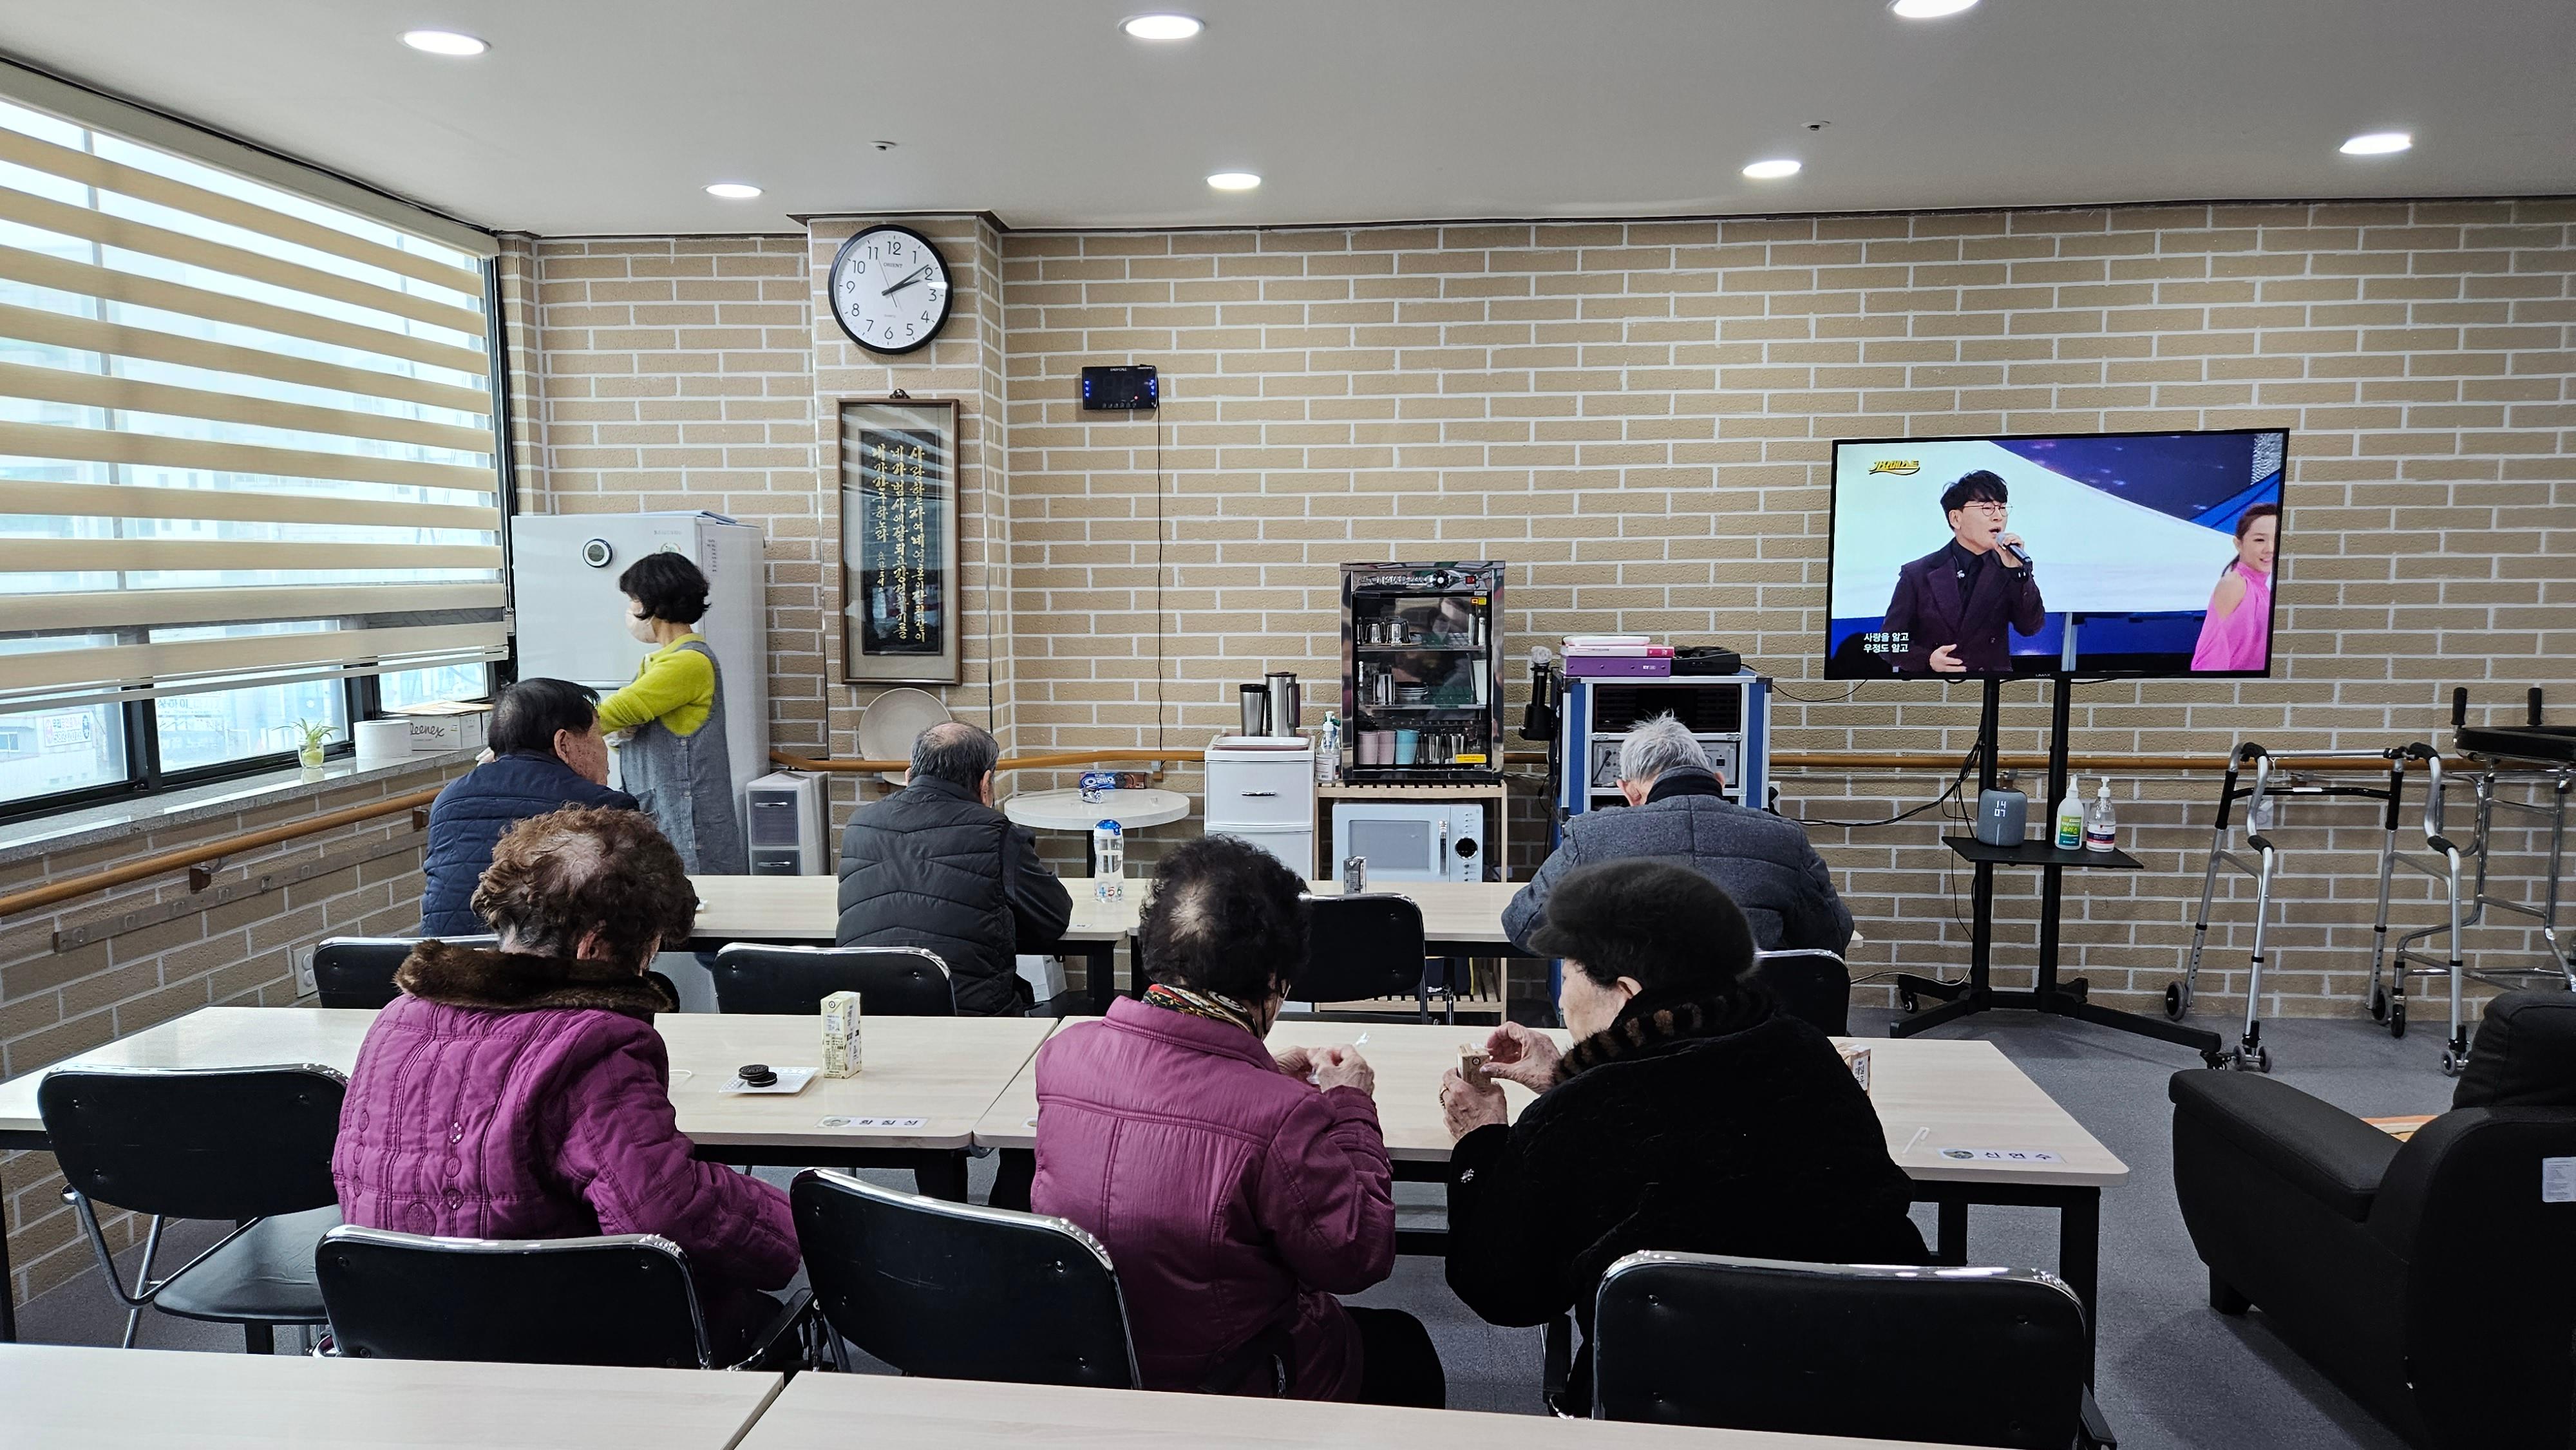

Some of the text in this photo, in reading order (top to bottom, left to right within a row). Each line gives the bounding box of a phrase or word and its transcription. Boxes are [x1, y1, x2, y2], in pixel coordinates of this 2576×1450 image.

[867, 247, 878, 260] 11
[887, 241, 902, 256] 12
[913, 251, 916, 264] 1
[853, 260, 866, 274] 10
[925, 267, 933, 281] 2
[846, 281, 855, 294] 9
[929, 288, 937, 301] 3
[851, 303, 859, 316] 8
[921, 310, 930, 323] 4
[866, 319, 874, 332] 7
[906, 323, 914, 336] 5
[885, 326, 893, 339] 6
[1864, 633, 1909, 642] 사랑을 알고
[1864, 644, 1909, 654] 우정도 알고
[1996, 800, 2006, 809] 14
[1994, 808, 2005, 816] 07
